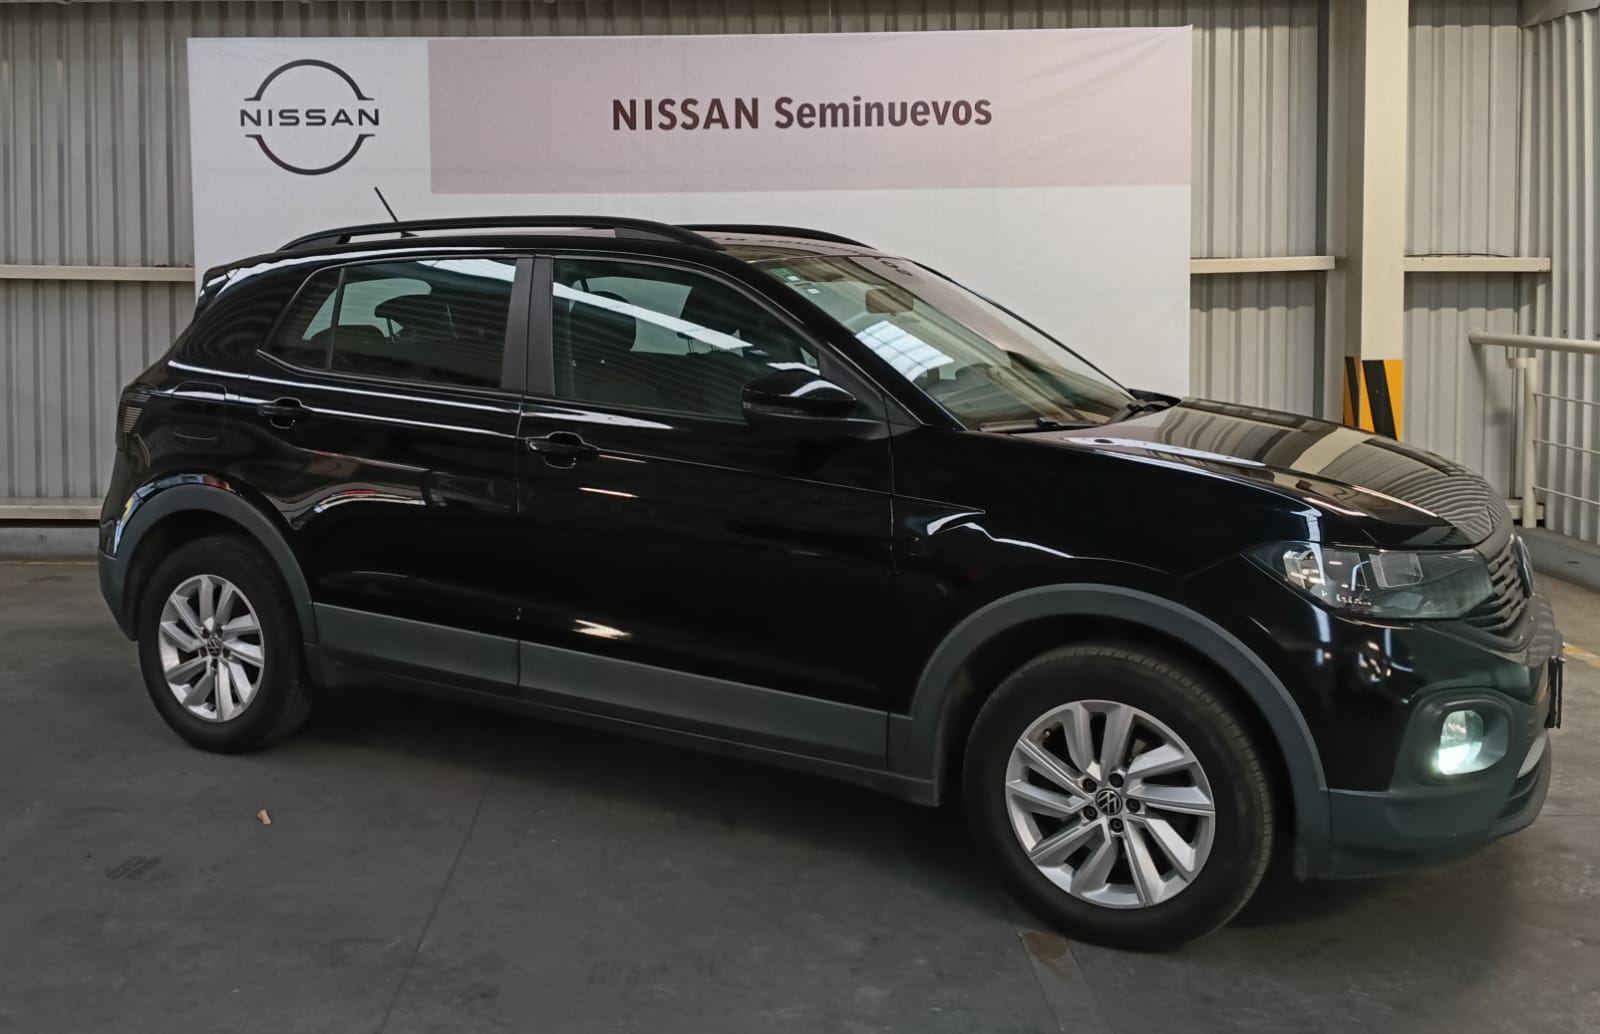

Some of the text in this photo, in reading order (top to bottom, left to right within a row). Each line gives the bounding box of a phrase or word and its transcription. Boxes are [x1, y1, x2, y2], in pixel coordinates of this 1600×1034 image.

[239, 108, 380, 127] NISSAN
[612, 95, 993, 131] NISSAN Seminuevos
